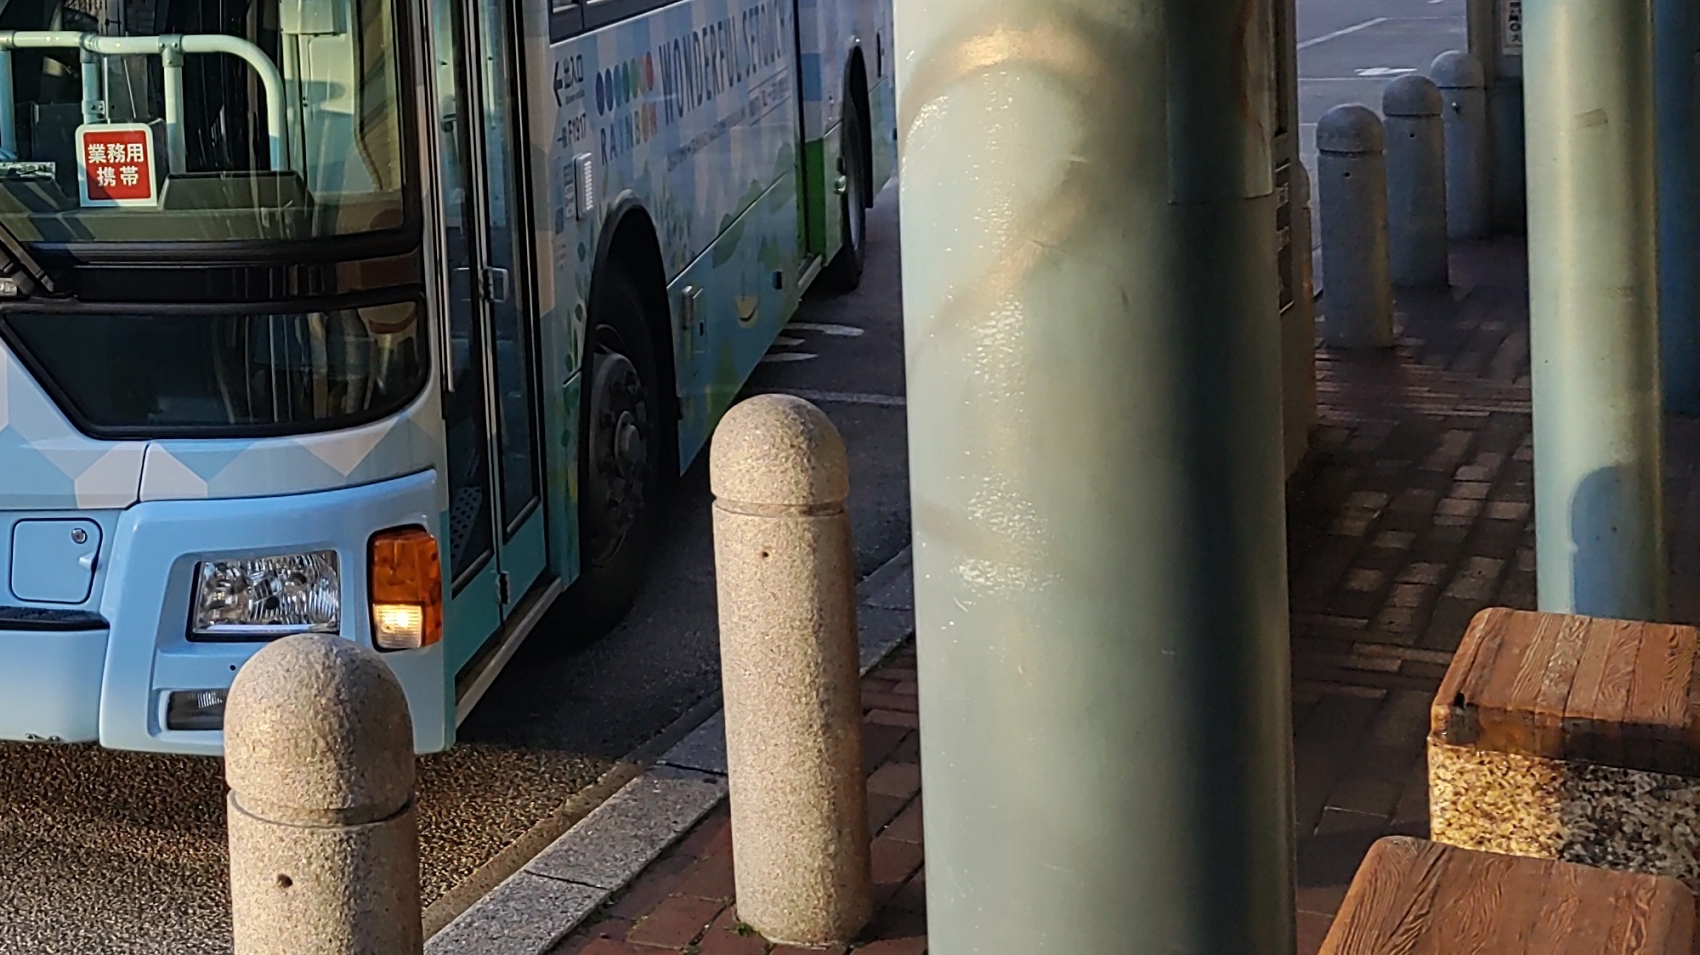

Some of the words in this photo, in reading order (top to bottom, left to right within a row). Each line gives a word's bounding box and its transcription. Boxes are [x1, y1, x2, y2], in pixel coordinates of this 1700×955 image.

[88, 142, 144, 164] 業務用
[96, 166, 139, 187] 携帯
